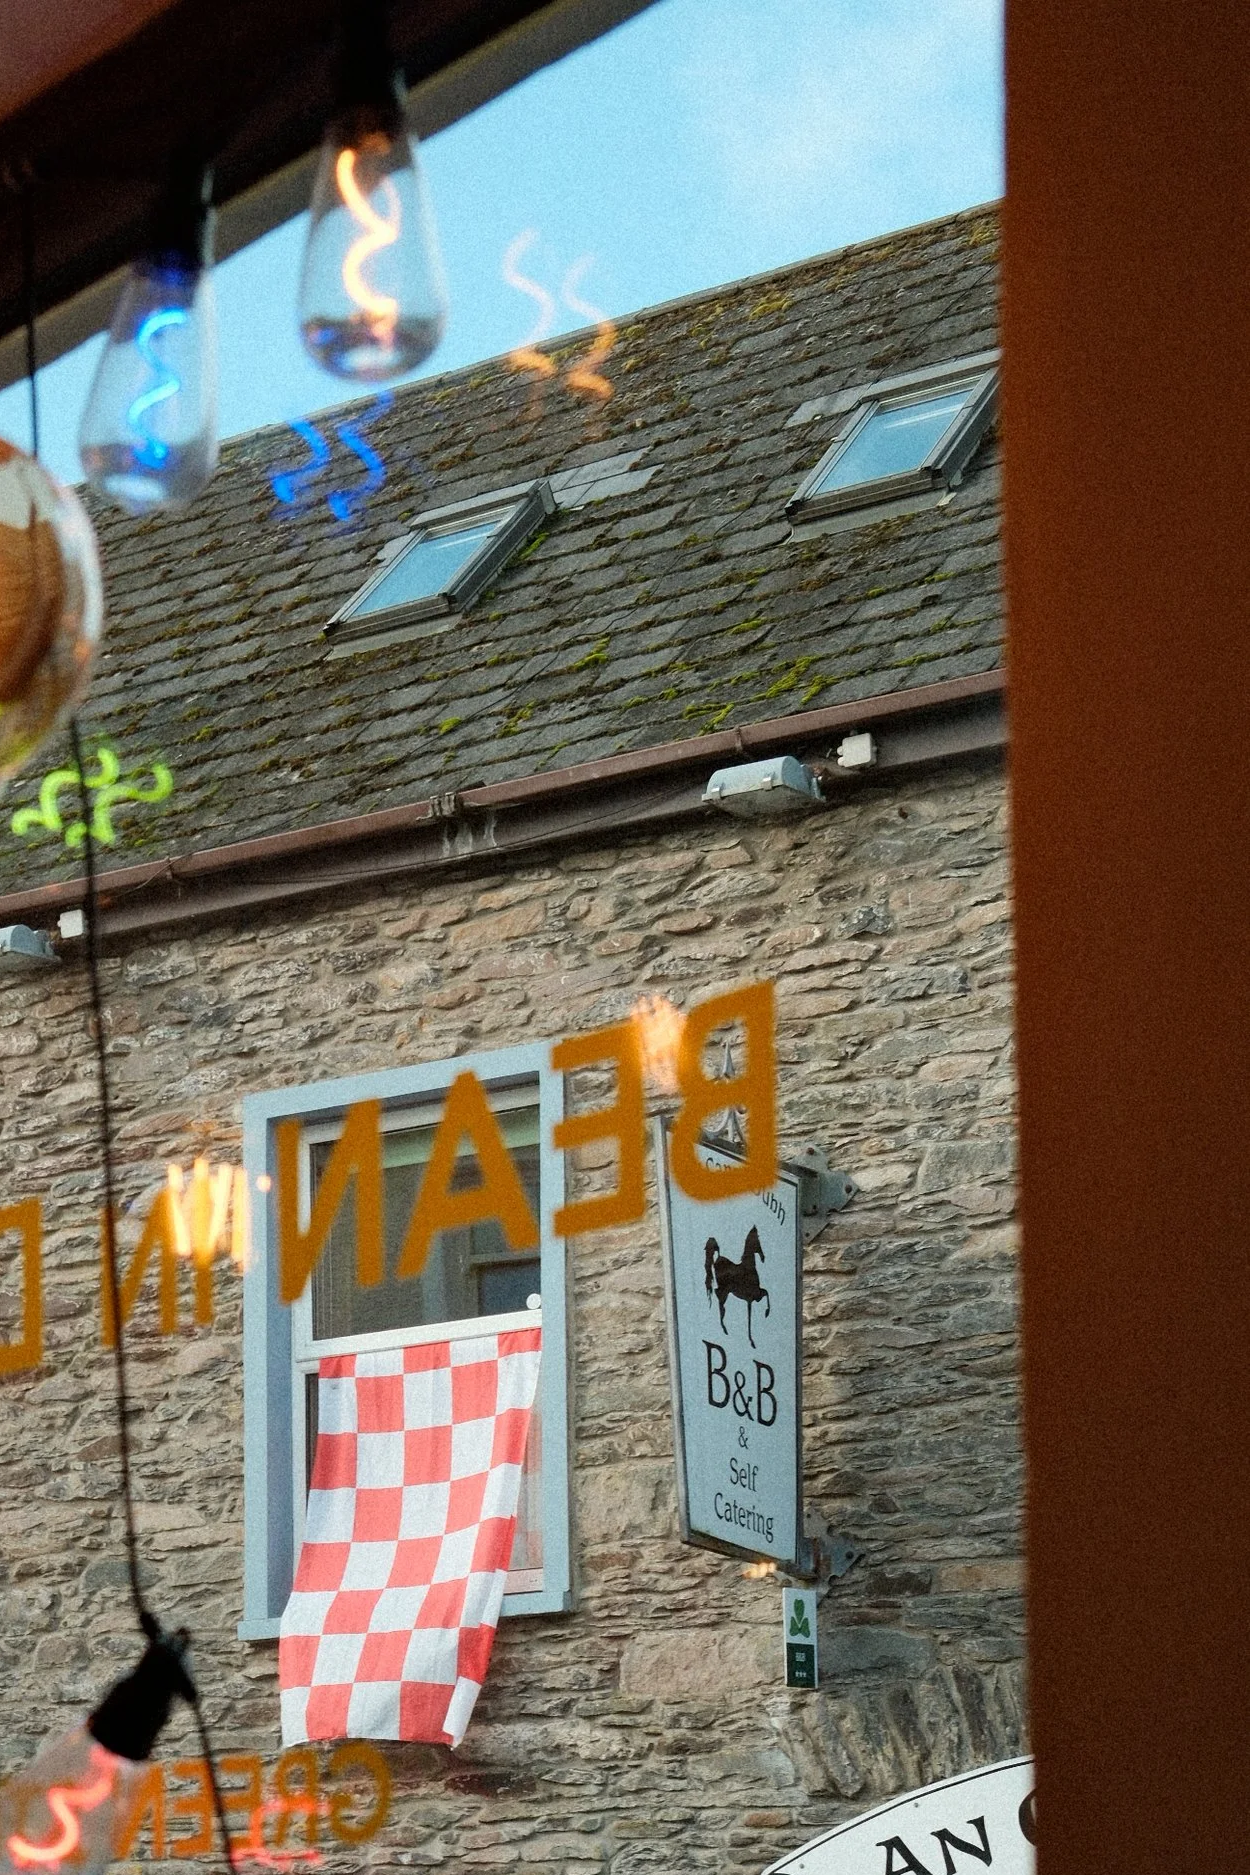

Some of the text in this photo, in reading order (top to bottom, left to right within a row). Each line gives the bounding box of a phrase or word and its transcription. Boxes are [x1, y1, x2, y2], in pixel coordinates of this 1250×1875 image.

[751, 1186, 786, 1226] ubh
[702, 1340, 777, 1427] B&B
[738, 1426, 748, 1449] &
[729, 1457, 759, 1493] Self
[714, 1492, 774, 1543] Catering
